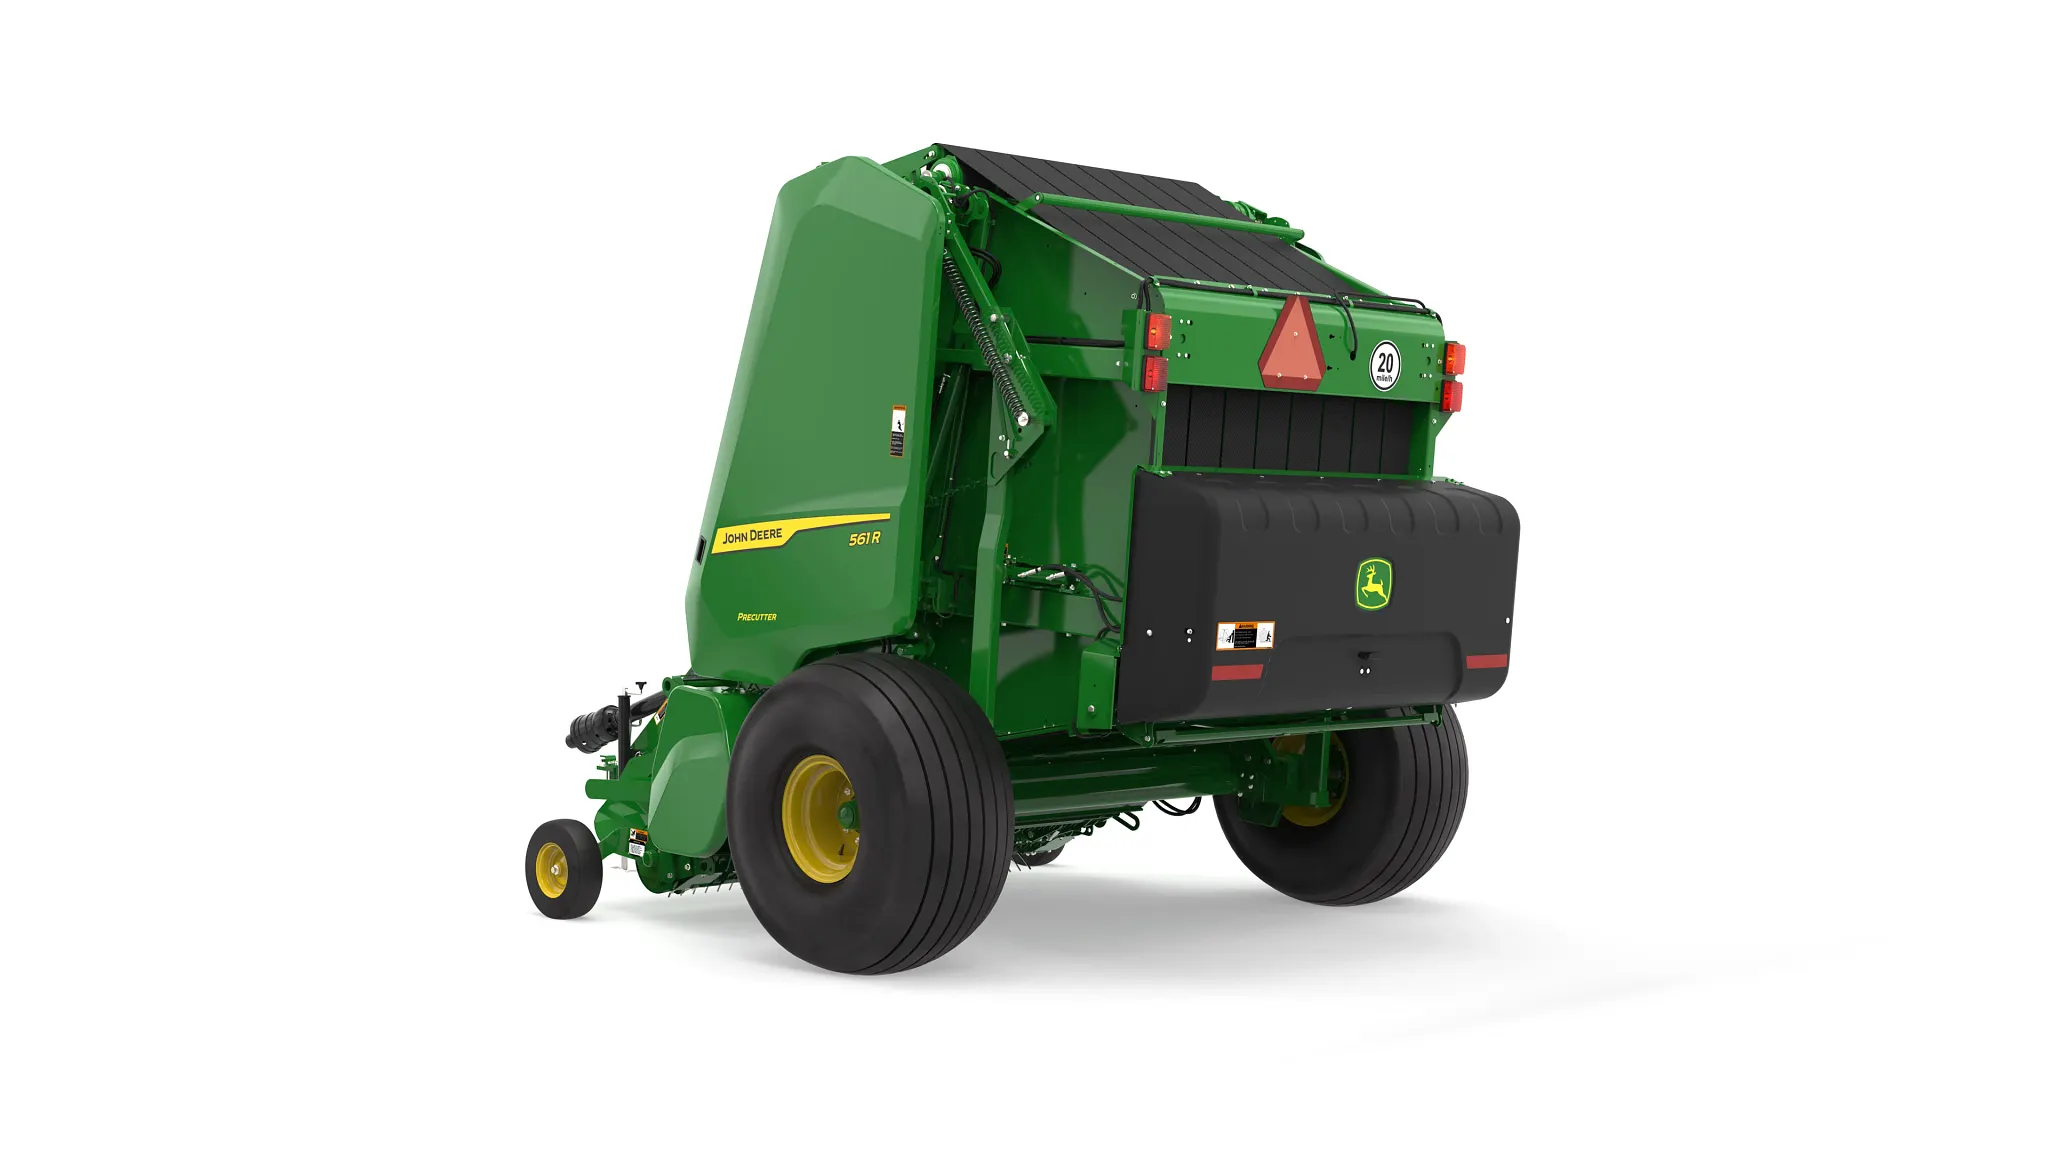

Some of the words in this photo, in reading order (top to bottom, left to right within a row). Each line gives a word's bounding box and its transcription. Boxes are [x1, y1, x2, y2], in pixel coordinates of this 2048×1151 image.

[1377, 352, 1394, 373] 20
[1376, 374, 1393, 382] mile/h
[723, 531, 748, 544] JOHN
[750, 528, 782, 541] DEERE
[848, 531, 871, 546] 561
[871, 530, 881, 543] R
[737, 612, 777, 622] PRECUTTER
